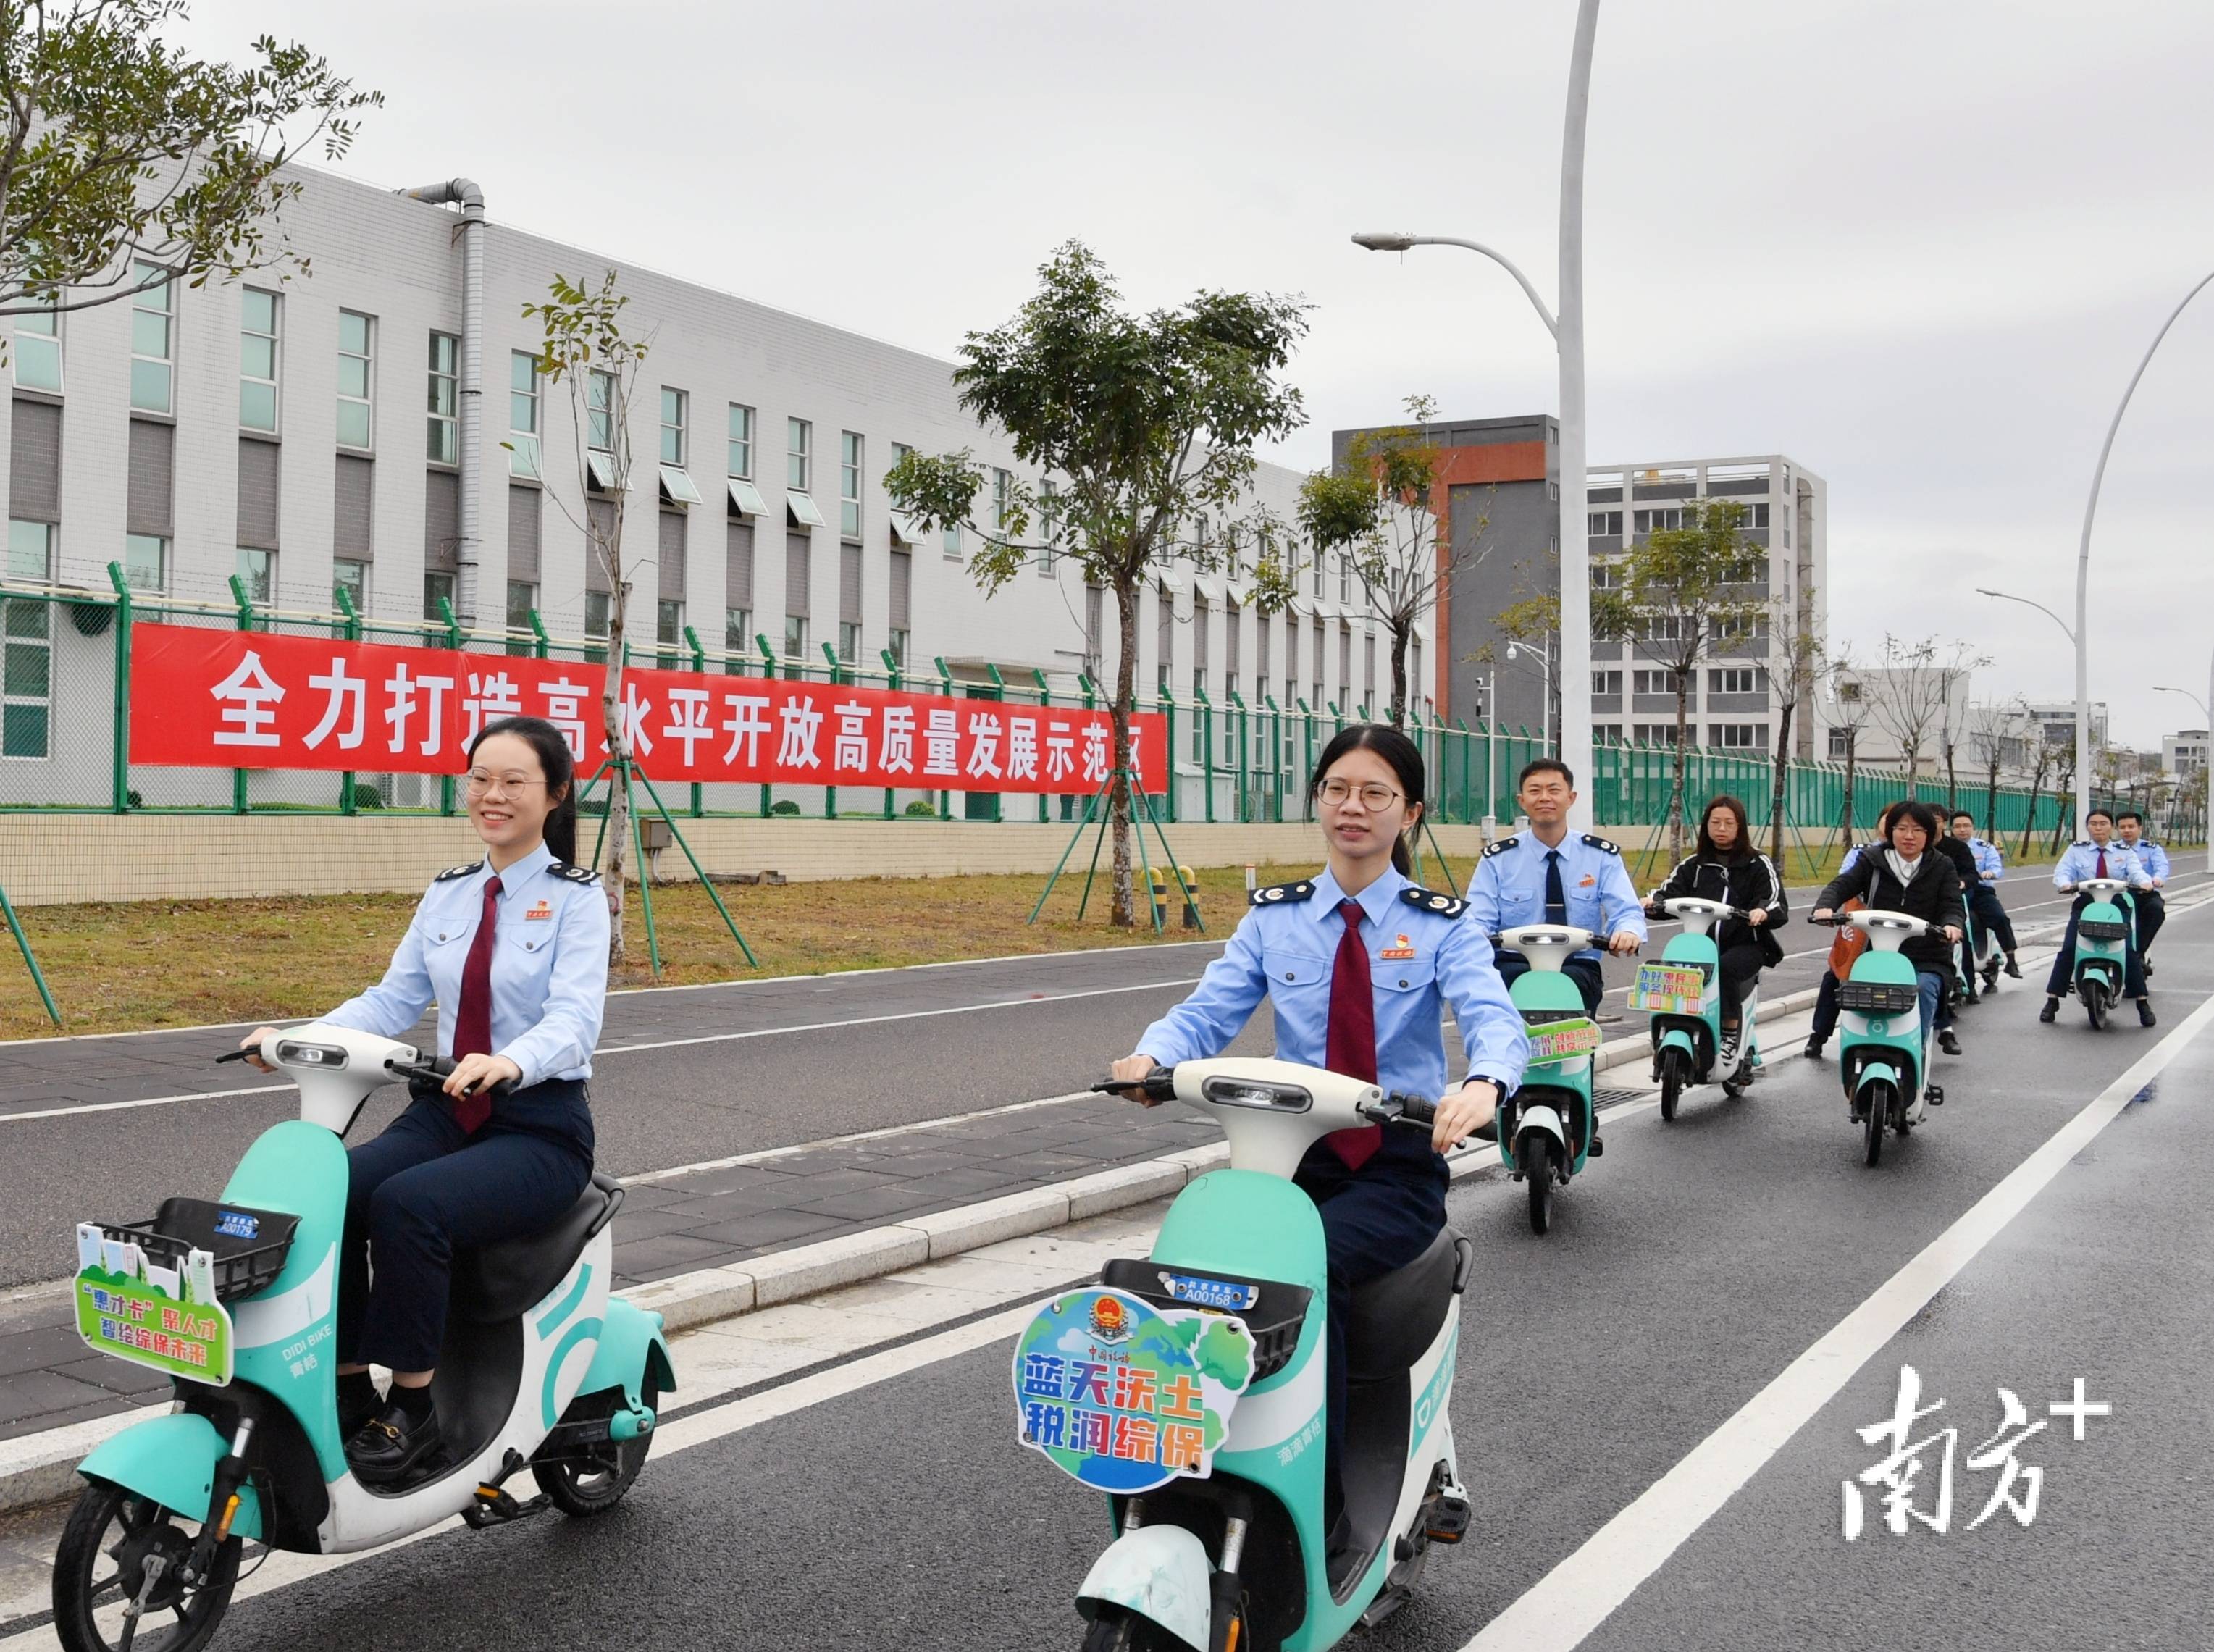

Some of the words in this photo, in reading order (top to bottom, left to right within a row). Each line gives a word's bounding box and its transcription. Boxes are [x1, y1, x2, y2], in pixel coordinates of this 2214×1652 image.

[1185, 1290, 1230, 1306] A00168
[100, 1317, 208, 1367] 智绘综保未来
[162, 1307, 218, 1342] 聚人才
[282, 1339, 307, 1361] DIDI
[307, 1323, 332, 1346] BIKE
[1023, 1352, 1204, 1420] 蓝天沃土
[1026, 1402, 1205, 1471] 税润综保
